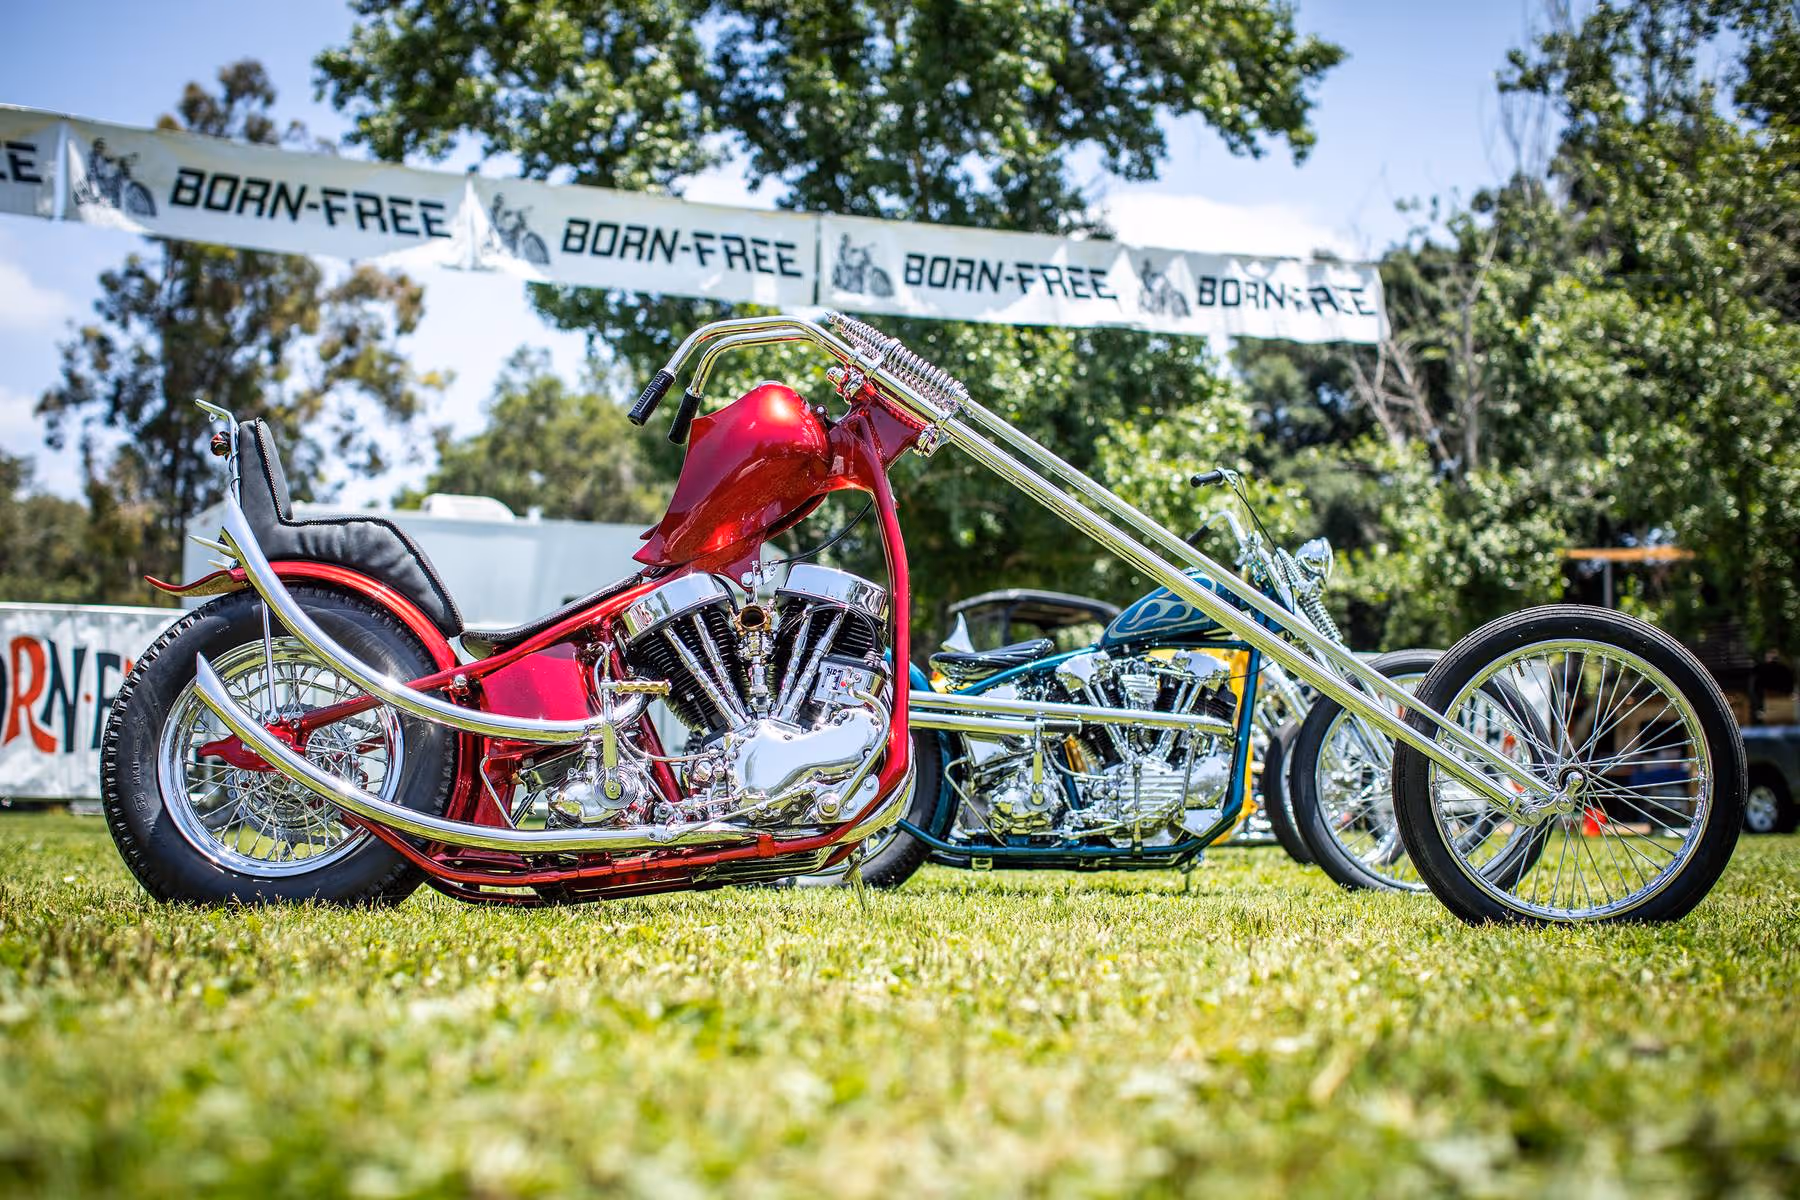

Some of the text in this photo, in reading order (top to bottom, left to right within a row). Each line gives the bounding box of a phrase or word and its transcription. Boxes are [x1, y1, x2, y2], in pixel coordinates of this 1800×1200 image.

[170, 166, 452, 238] BORN-FREE
[561, 217, 802, 278] BORN-FREE
[904, 253, 1118, 299] BORN-FREE
